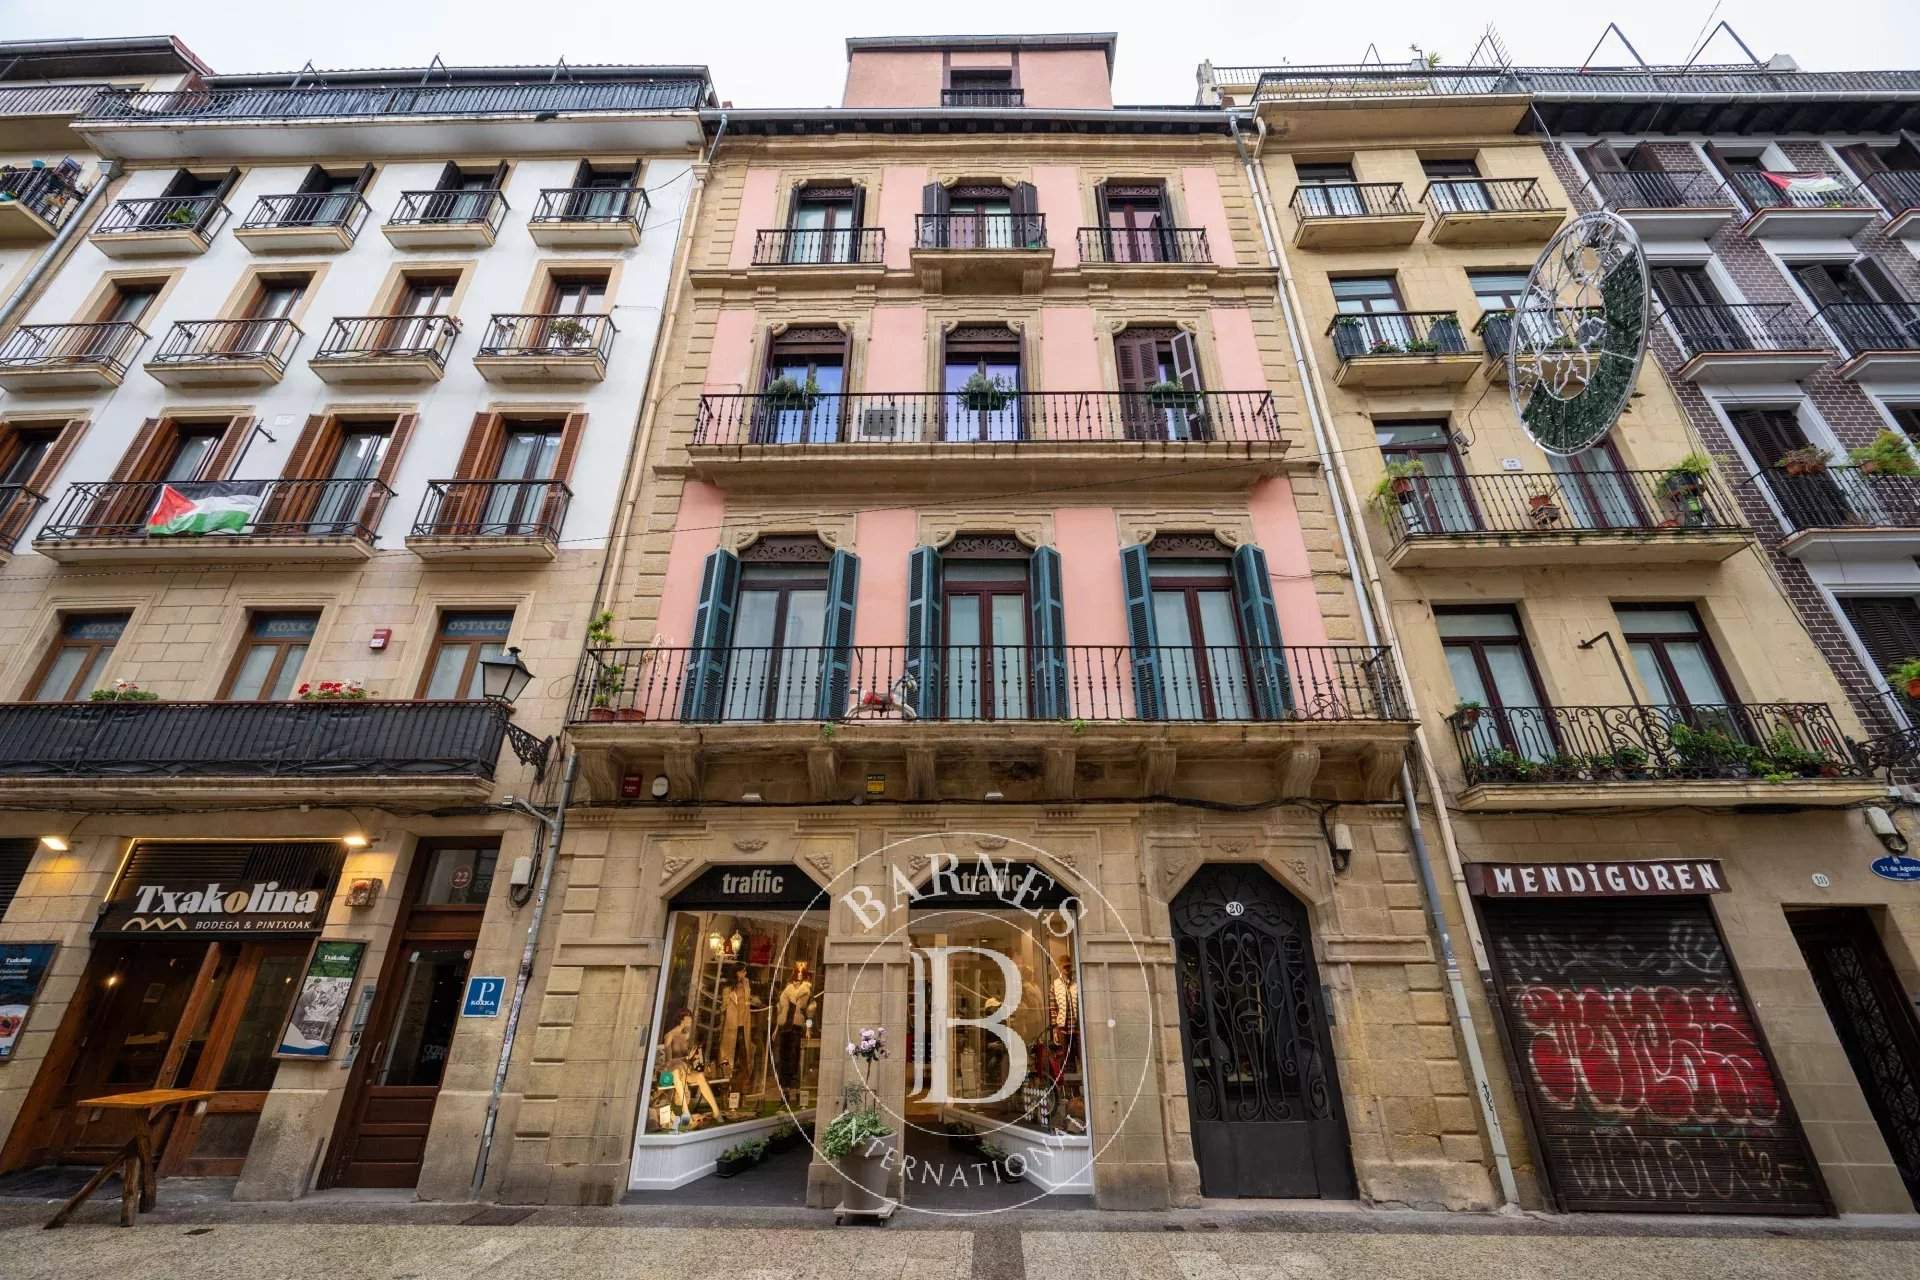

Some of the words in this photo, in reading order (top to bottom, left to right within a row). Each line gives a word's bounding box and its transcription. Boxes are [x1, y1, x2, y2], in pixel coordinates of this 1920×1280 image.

[267, 621, 318, 632] KOXK
[454, 871, 469, 882] 22
[722, 869, 784, 894] traffic
[133, 880, 319, 914] Txakolina
[1228, 903, 1242, 914] 20
[195, 920, 240, 930] BODEGA
[243, 920, 252, 929] &
[255, 920, 312, 930] PINTXOAK
[478, 982, 496, 1002] P
